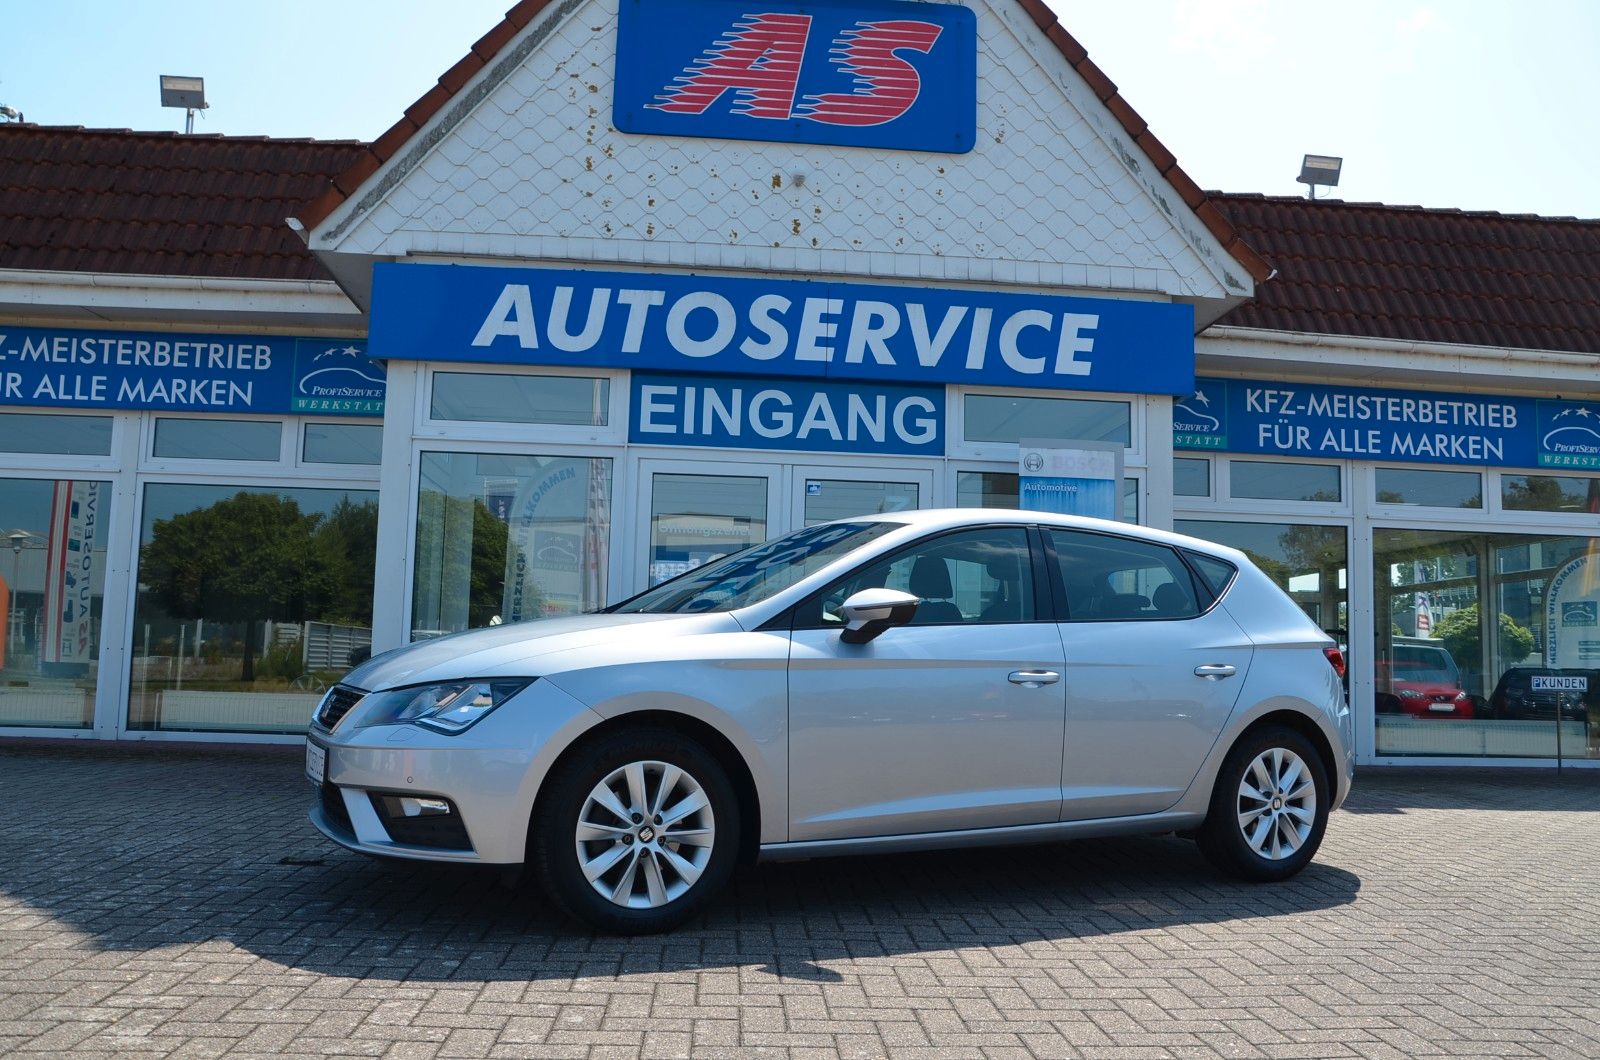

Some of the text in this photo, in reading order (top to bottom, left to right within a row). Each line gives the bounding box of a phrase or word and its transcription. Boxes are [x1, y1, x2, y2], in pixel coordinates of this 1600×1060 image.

[643, 13, 944, 127] AS
[471, 283, 1099, 376] AUTOSERVICE
[33, 373, 107, 401] ALLE
[117, 377, 252, 406] MARKEN
[1246, 388, 1518, 429] KFZ-MEISTERBETRIEB
[639, 385, 937, 444] EINGANG
[1258, 418, 1503, 460] FÜR ALLE MARKEN
[1024, 482, 1078, 493] Automotive
[1542, 678, 1586, 689] KUNDEN
